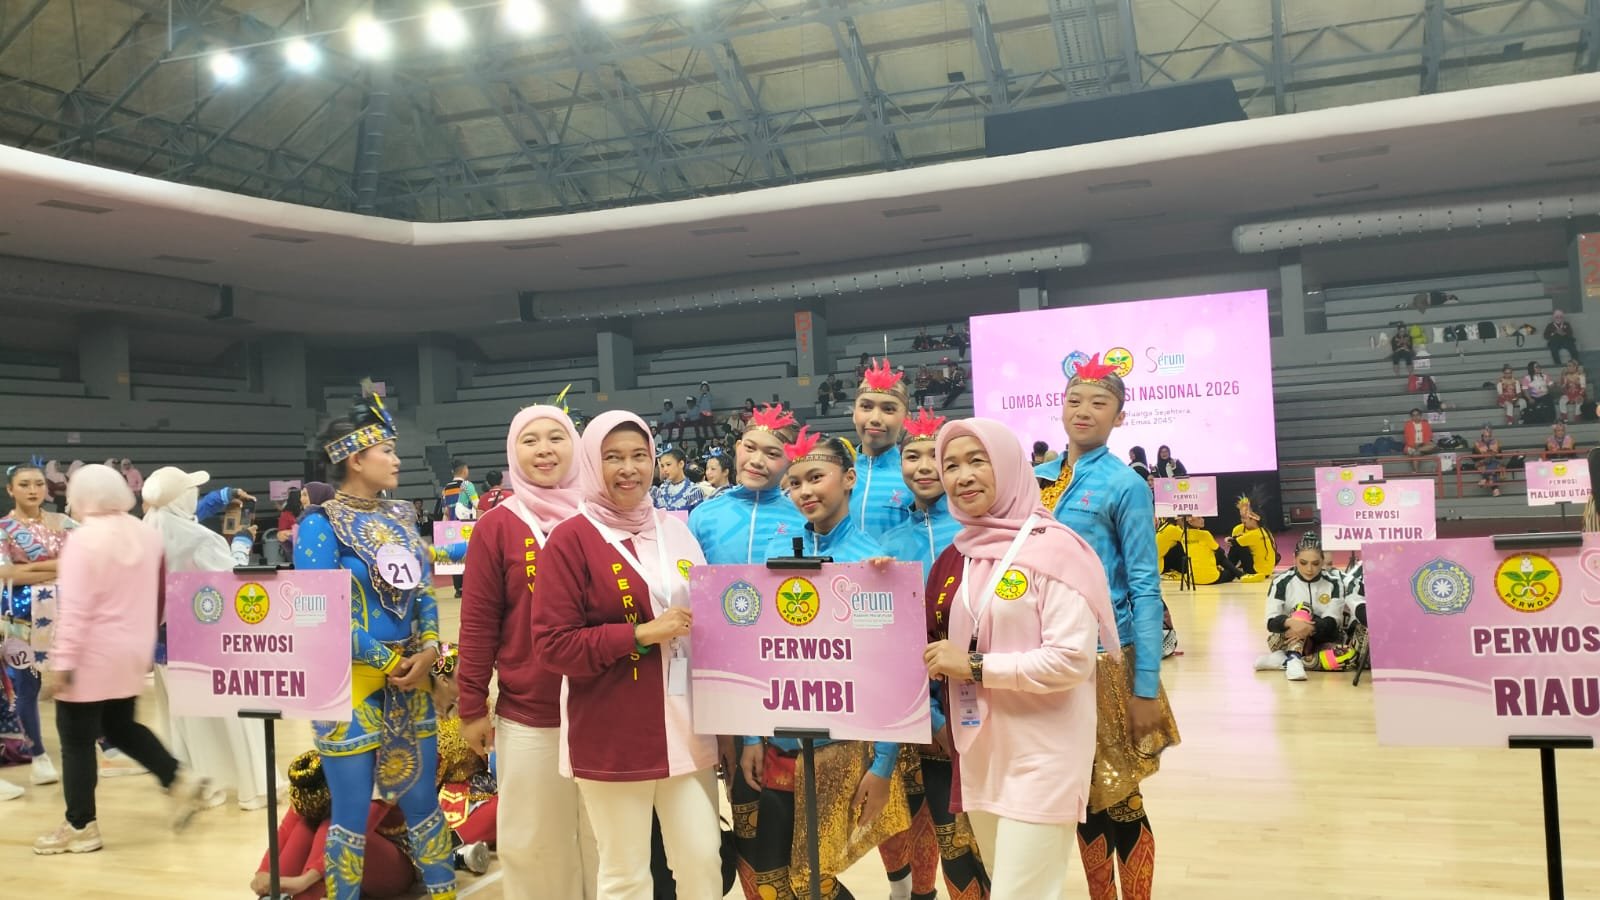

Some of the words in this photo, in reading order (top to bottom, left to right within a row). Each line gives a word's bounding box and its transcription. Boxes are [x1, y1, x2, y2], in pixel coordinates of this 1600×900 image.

[1002, 393, 1042, 410] LOMBA
[1139, 383, 1202, 401] NASIONAL
[1205, 380, 1240, 397] 2026
[1530, 489, 1566, 499] MALUKU
[1173, 503, 1199, 511] PAPUA
[1355, 510, 1400, 519] PERWOSI
[1335, 527, 1373, 540] JAWA
[1379, 527, 1423, 540] TIMUR
[388, 563, 414, 584] 21
[280, 582, 326, 621] Seruni
[830, 575, 893, 622] Seruni
[1505, 591, 1554, 609] PERWOSI
[611, 563, 640, 681] PERWSI
[782, 608, 815, 623] PERWOSI
[222, 634, 293, 653] PERWOSI
[761, 637, 852, 660] PERWOSI
[1474, 625, 1600, 654] PERWOS
[212, 669, 306, 698] BANTEN
[763, 679, 854, 713] JAMBI
[1494, 677, 1600, 717] RIAU
